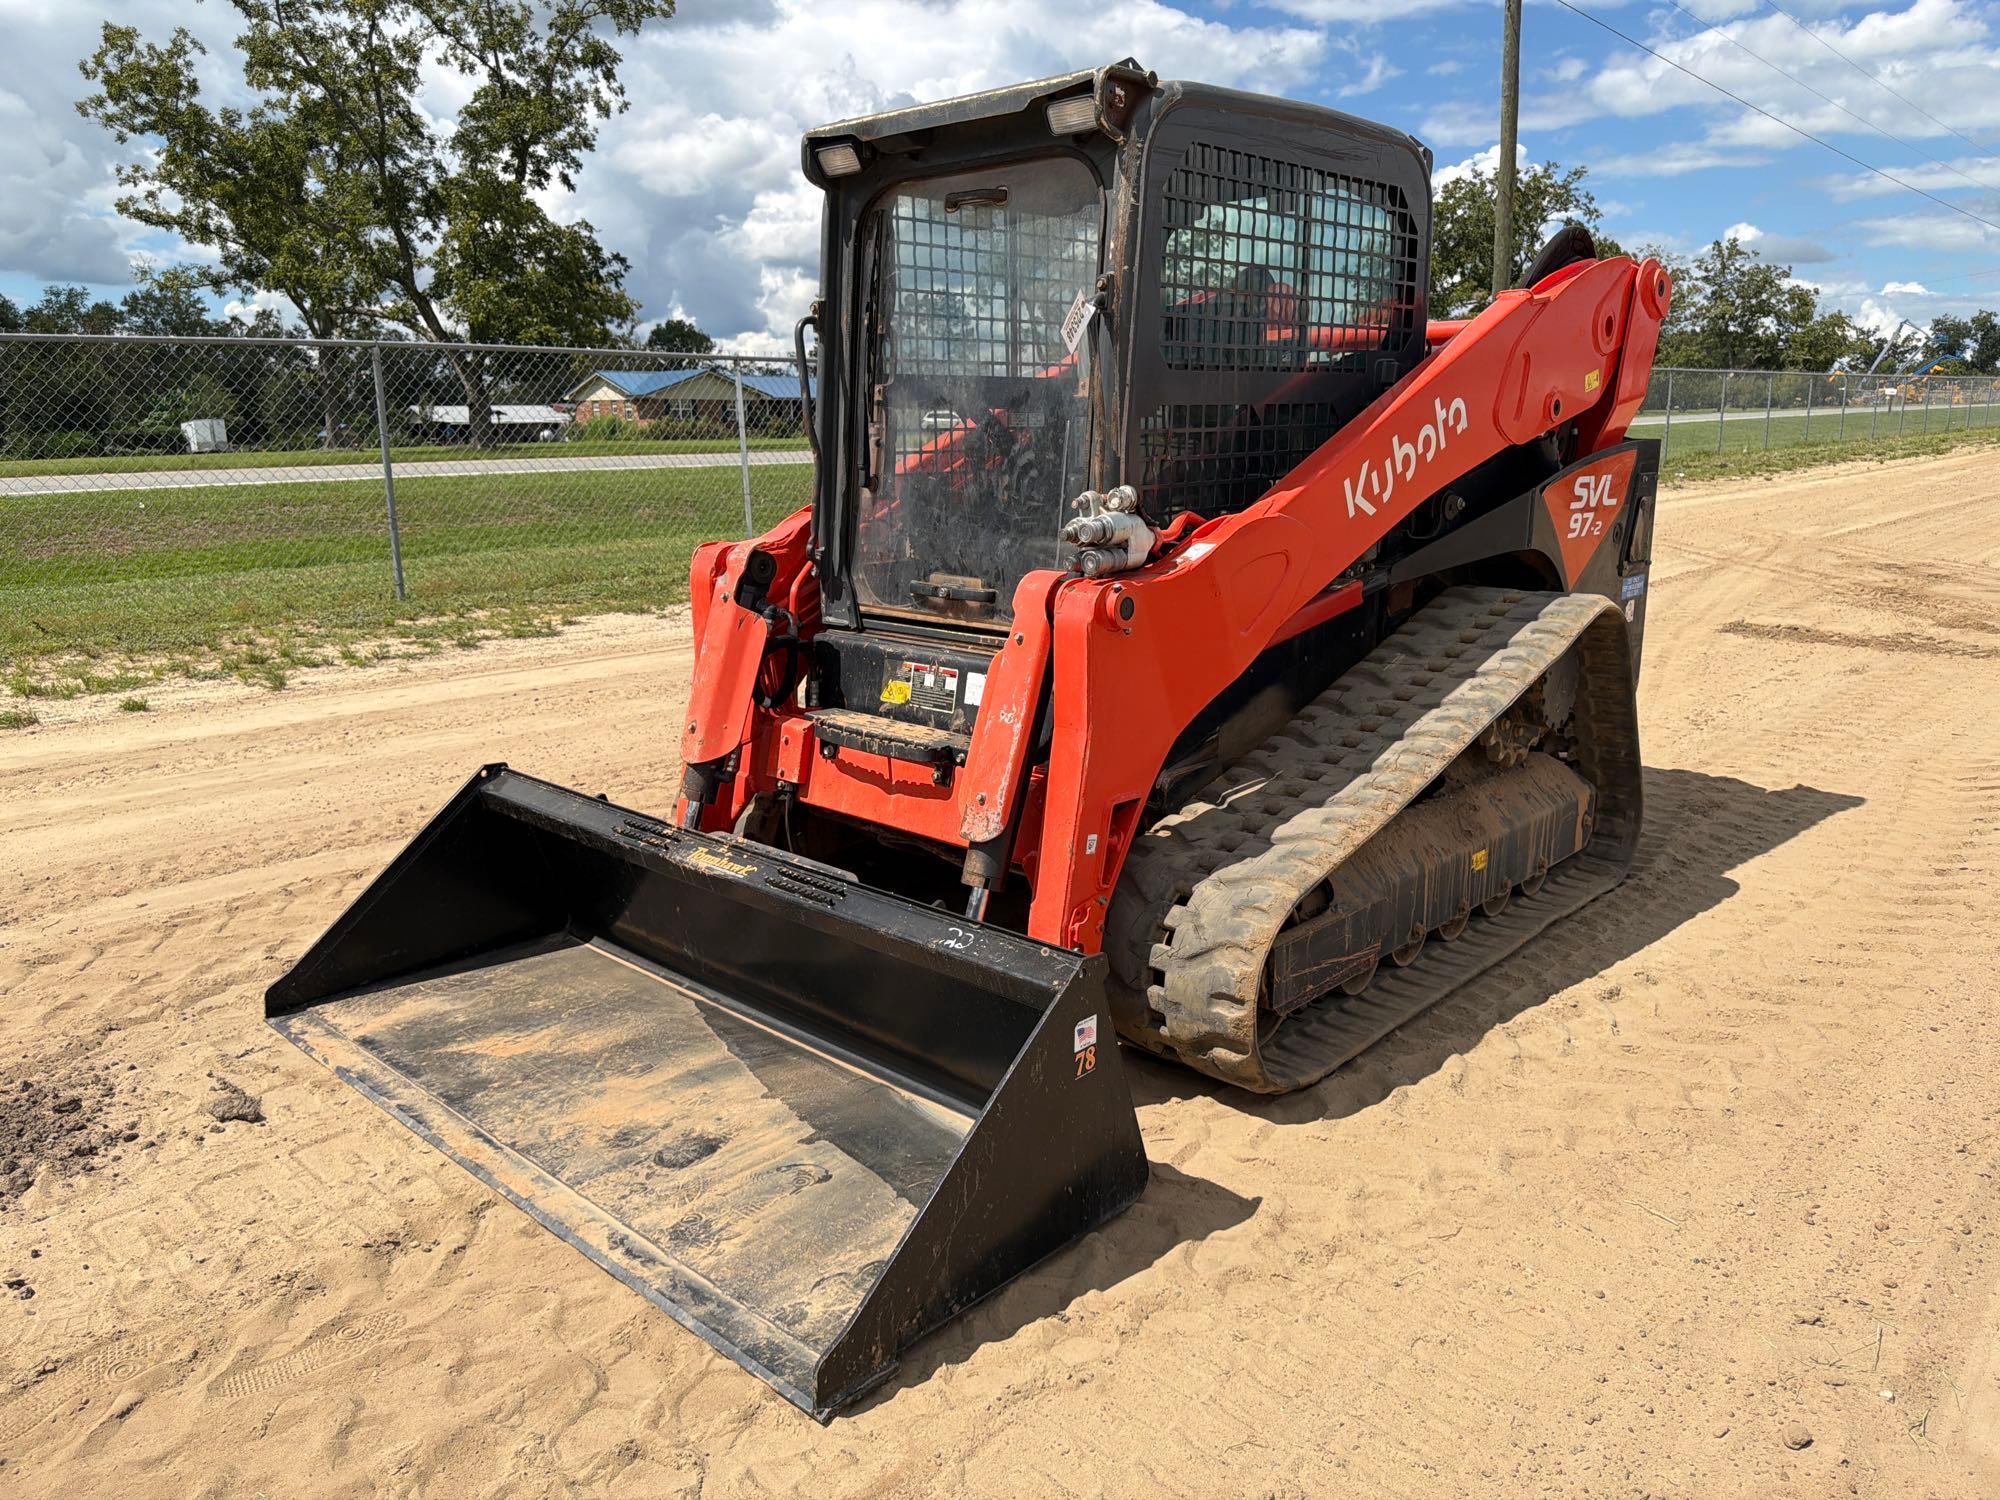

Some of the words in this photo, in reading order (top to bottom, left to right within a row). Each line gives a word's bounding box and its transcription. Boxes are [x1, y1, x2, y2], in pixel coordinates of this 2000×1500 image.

[1067, 307, 1084, 343] 225348
[1344, 397, 1468, 518] Kubota
[1569, 474, 1617, 510] SVL
[1567, 512, 1601, 539] 97-2
[1075, 1046, 1096, 1076] 78
